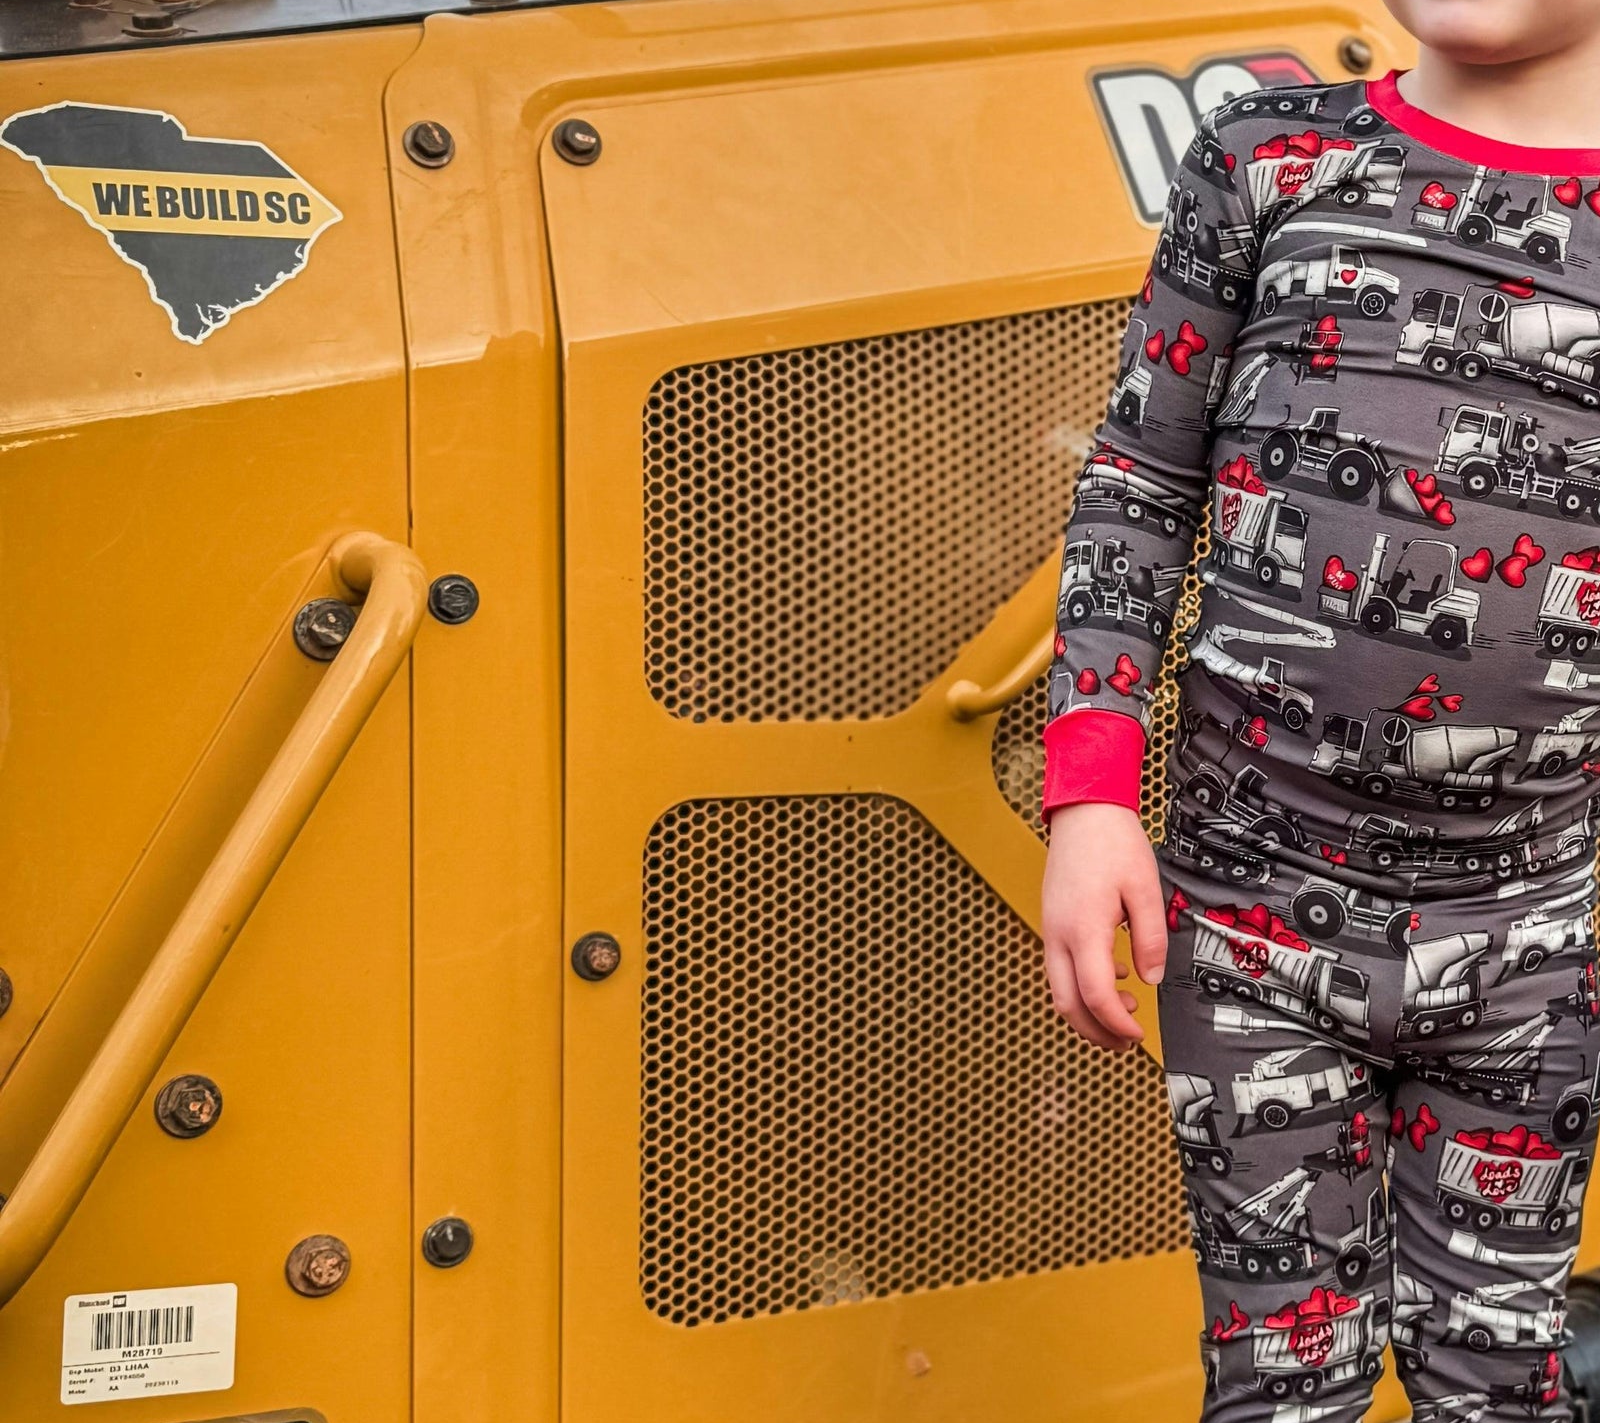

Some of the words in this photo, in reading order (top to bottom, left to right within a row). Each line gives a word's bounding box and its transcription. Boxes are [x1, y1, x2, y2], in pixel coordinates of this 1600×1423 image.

[92, 183, 152, 218] WE
[155, 186, 260, 222] BUILD
[266, 191, 312, 225] SC
[1480, 1166, 1521, 1181] Loads
[1482, 1181, 1518, 1197] Love
[121, 1347, 163, 1359] M28719
